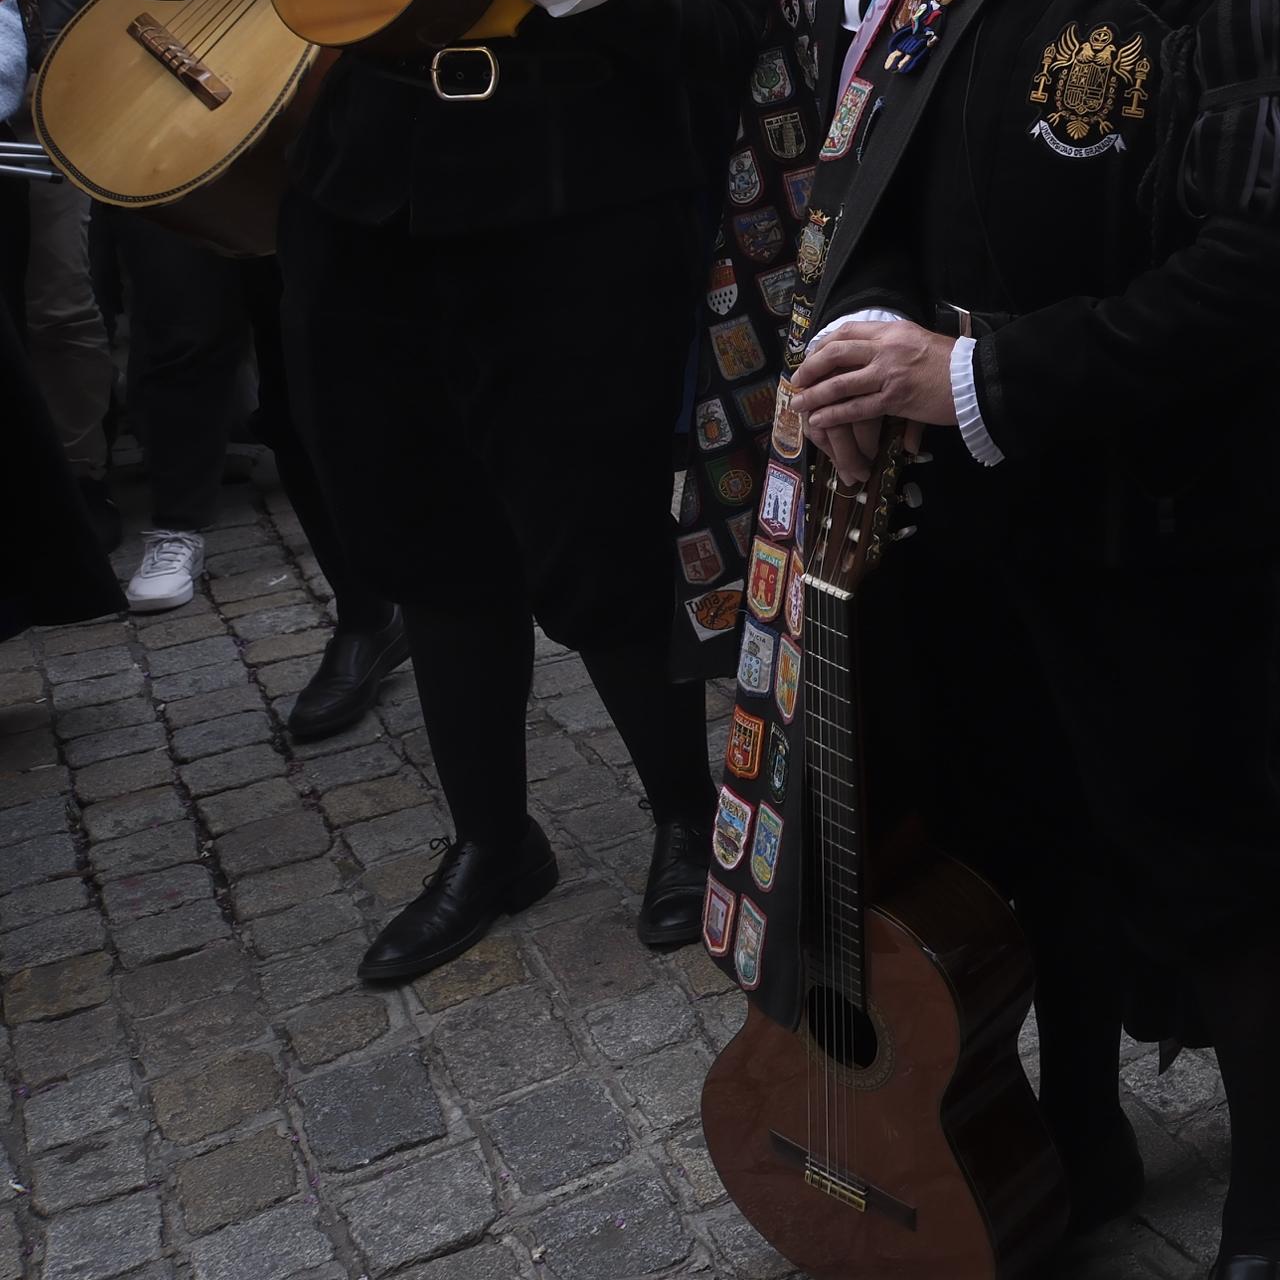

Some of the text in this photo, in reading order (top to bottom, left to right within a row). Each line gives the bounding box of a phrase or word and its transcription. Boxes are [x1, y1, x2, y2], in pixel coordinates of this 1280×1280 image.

[1041, 123, 1116, 157] UNIVERSIDAD DE GRANADA
[686, 591, 722, 615] Tuna
